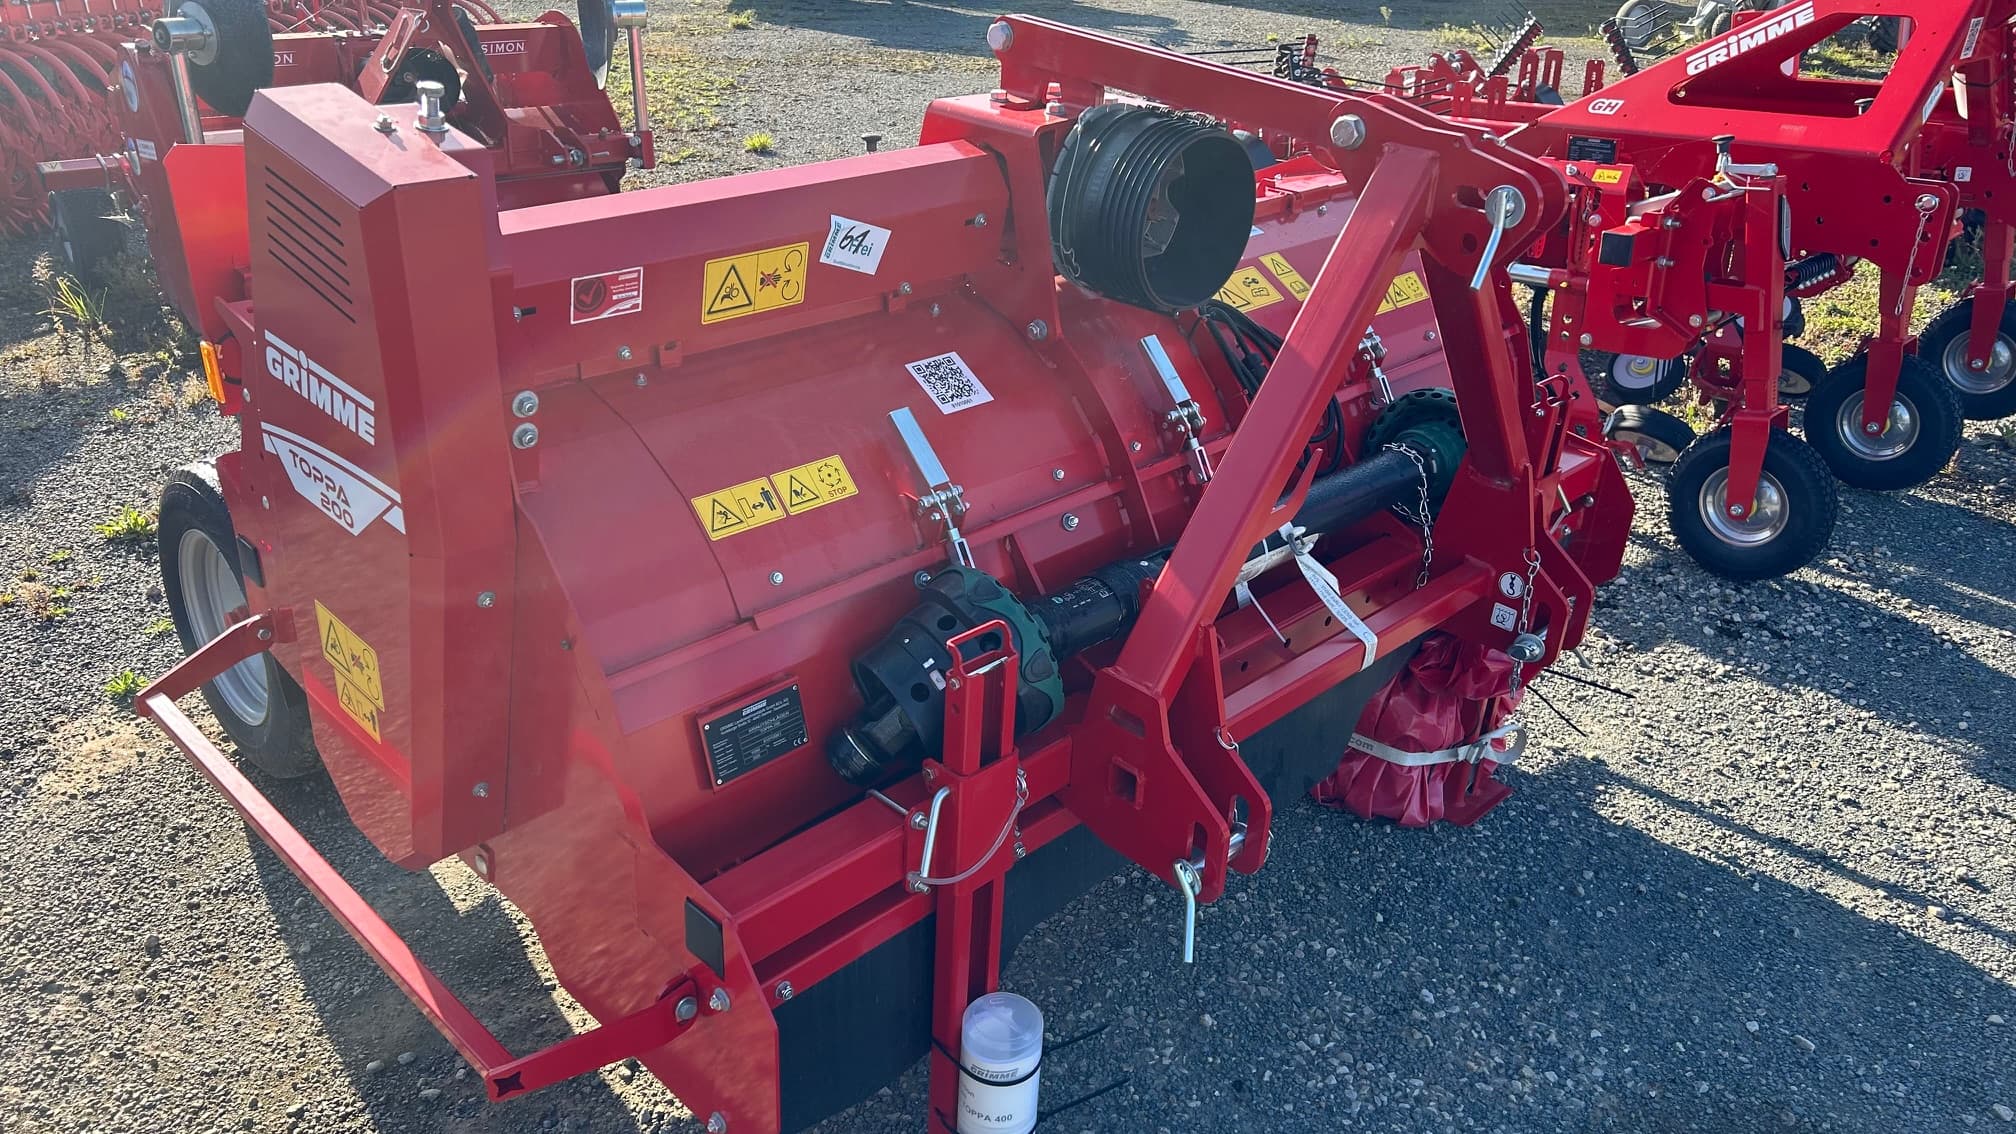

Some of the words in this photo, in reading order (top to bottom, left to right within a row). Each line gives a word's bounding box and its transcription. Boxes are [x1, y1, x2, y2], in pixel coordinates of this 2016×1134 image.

[480, 42, 525, 54] SIMON
[1591, 101, 1620, 112] GH
[289, 449, 352, 508] TOPPA
[827, 486, 849, 498] STOP
[320, 492, 355, 529] 200
[994, 1113, 1013, 1123] 400
